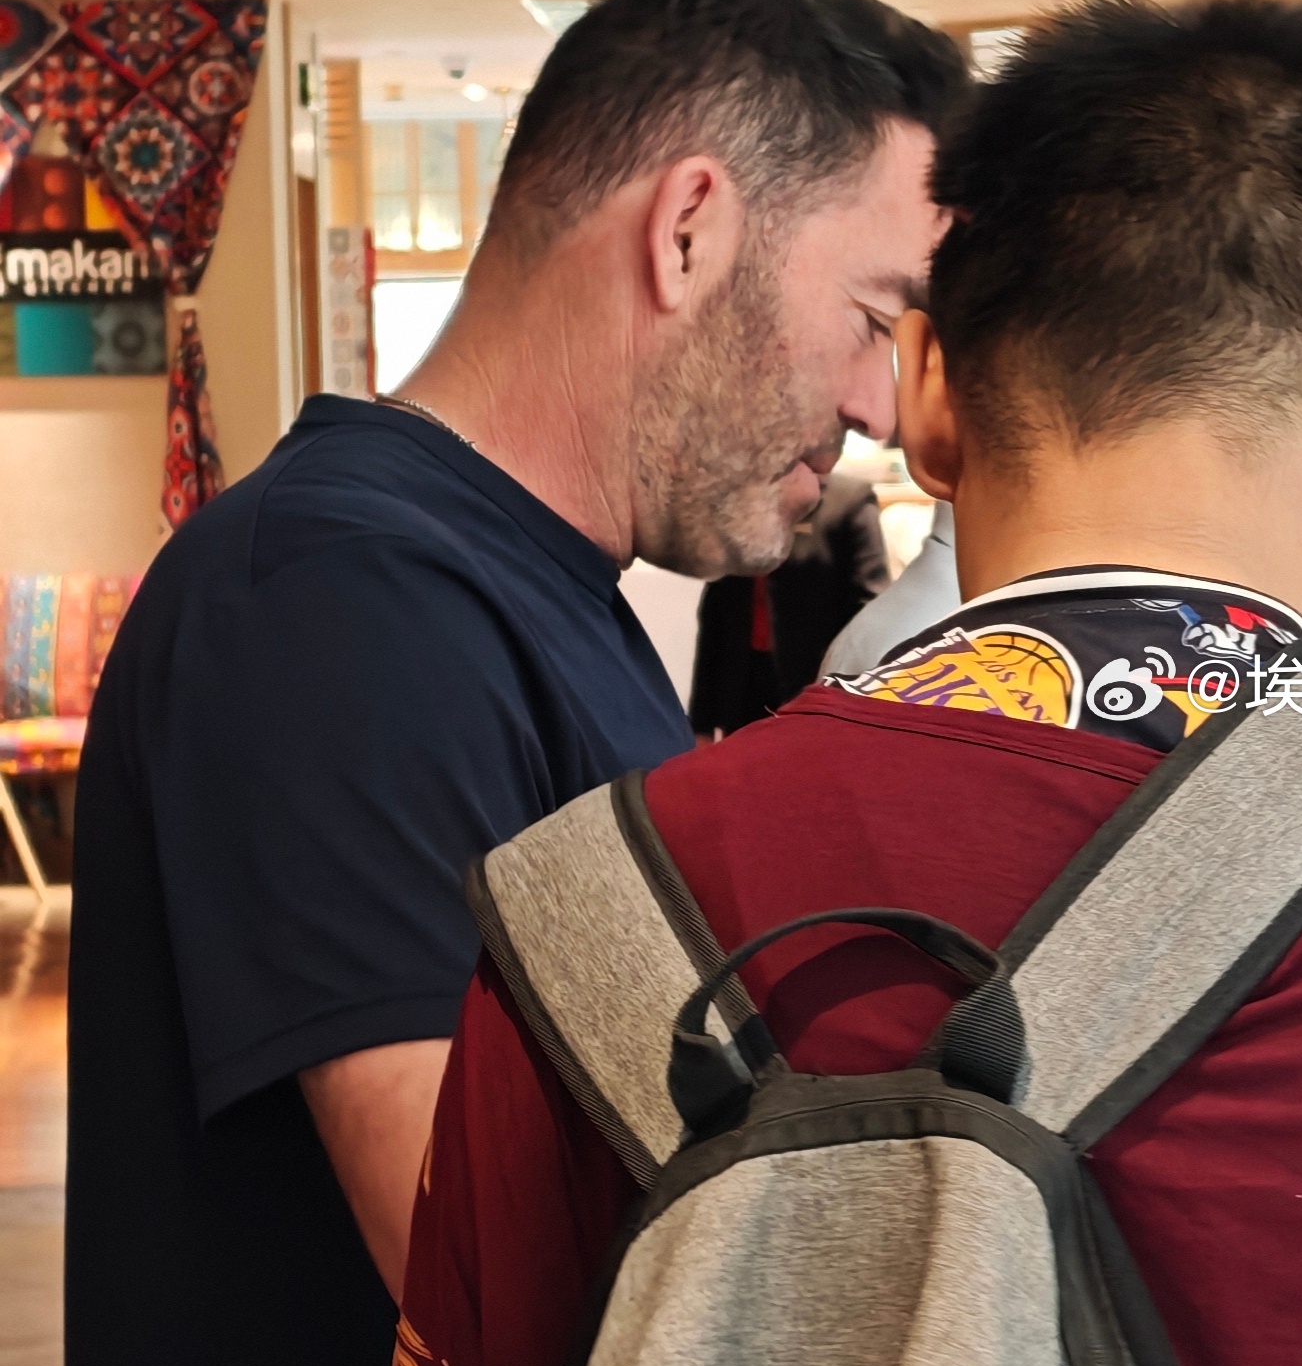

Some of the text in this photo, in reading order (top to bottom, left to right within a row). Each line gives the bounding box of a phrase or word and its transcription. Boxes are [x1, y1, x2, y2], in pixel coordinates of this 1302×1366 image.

[0, 238, 149, 284] makan
[973, 660, 1017, 684] LOS
[1007, 688, 1053, 722] AN
